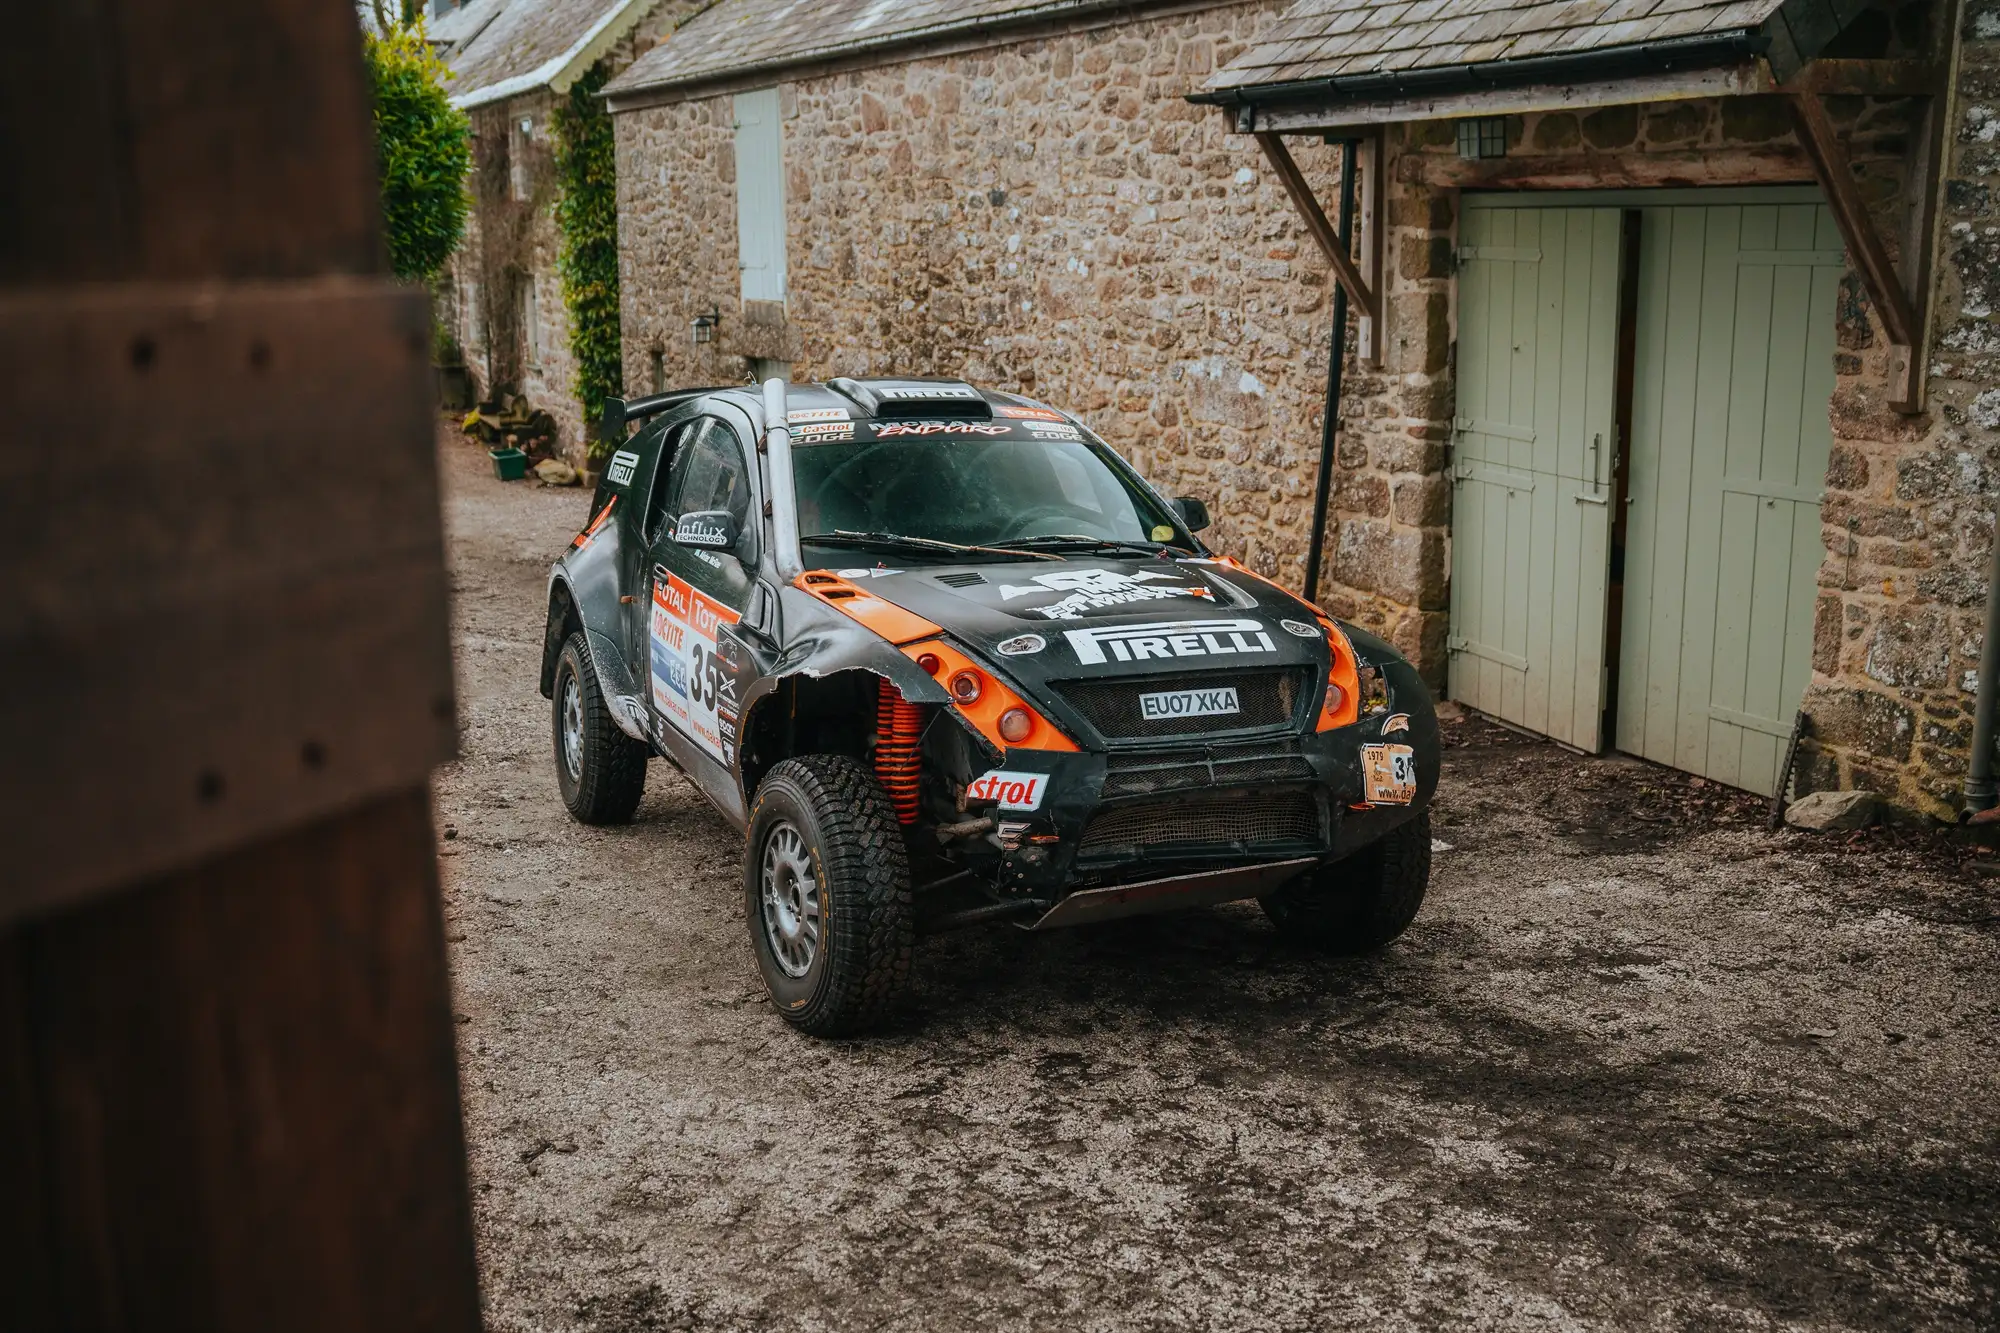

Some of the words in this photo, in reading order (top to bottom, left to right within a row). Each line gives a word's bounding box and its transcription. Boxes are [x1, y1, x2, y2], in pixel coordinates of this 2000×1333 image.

[788, 410, 841, 419] OCTITE
[802, 423, 850, 434] Castrol
[876, 424, 1012, 437] ENDURO
[790, 432, 855, 446] EDGE
[1030, 431, 1085, 441] EDGE
[676, 520, 726, 537] influx
[676, 534, 726, 544] TECHNOLOGY
[1062, 618, 1278, 666] PIRELLI
[1143, 693, 1193, 716] EU07
[1195, 691, 1238, 712] XKA
[1367, 751, 1384, 761] 1979
